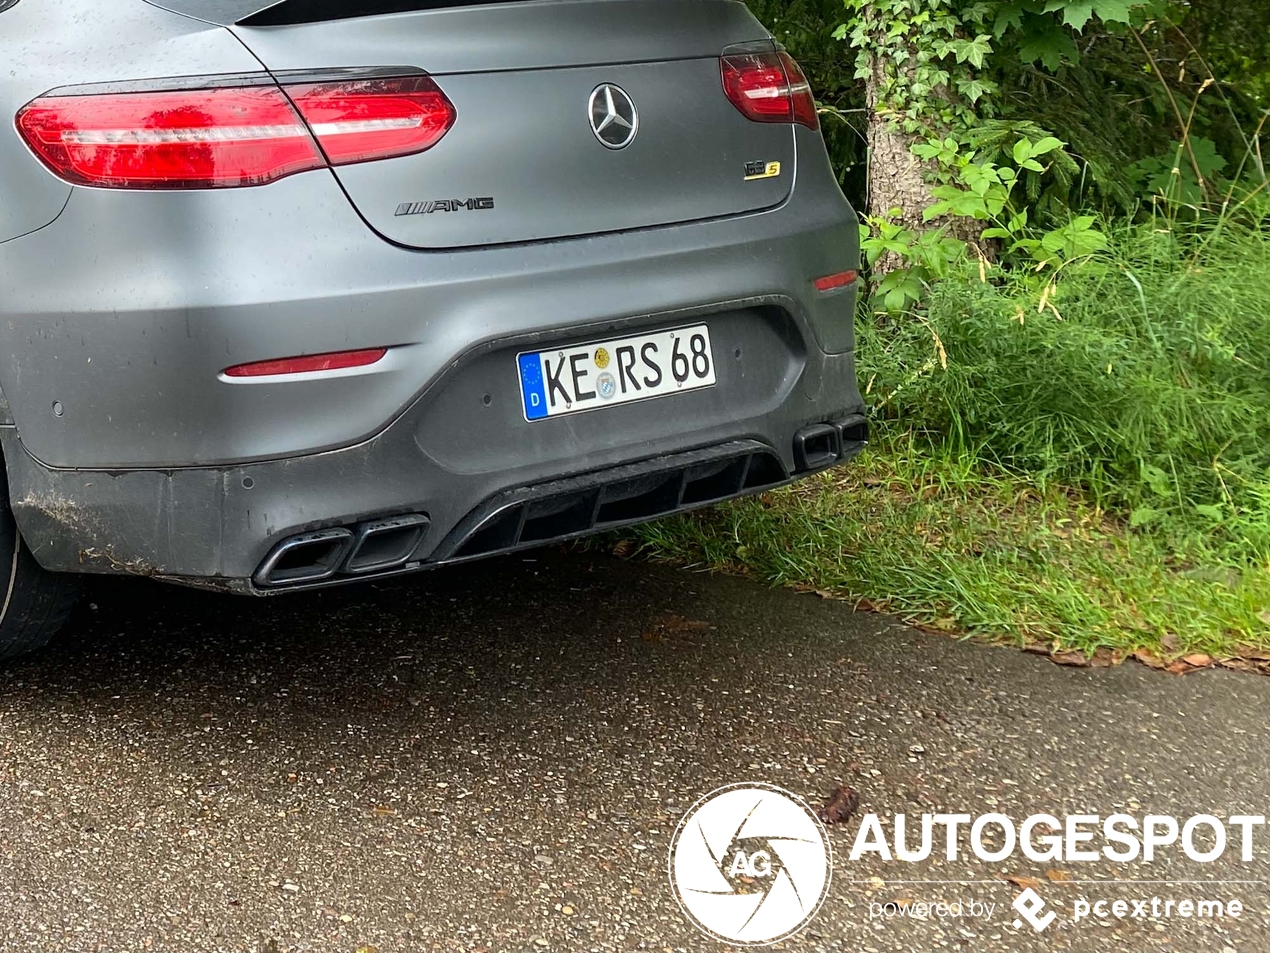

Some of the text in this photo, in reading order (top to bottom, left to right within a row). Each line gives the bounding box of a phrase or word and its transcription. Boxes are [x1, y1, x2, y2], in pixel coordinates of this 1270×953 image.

[428, 197, 494, 213] AMG
[544, 333, 710, 408] KE RS 68
[531, 393, 540, 407] D
